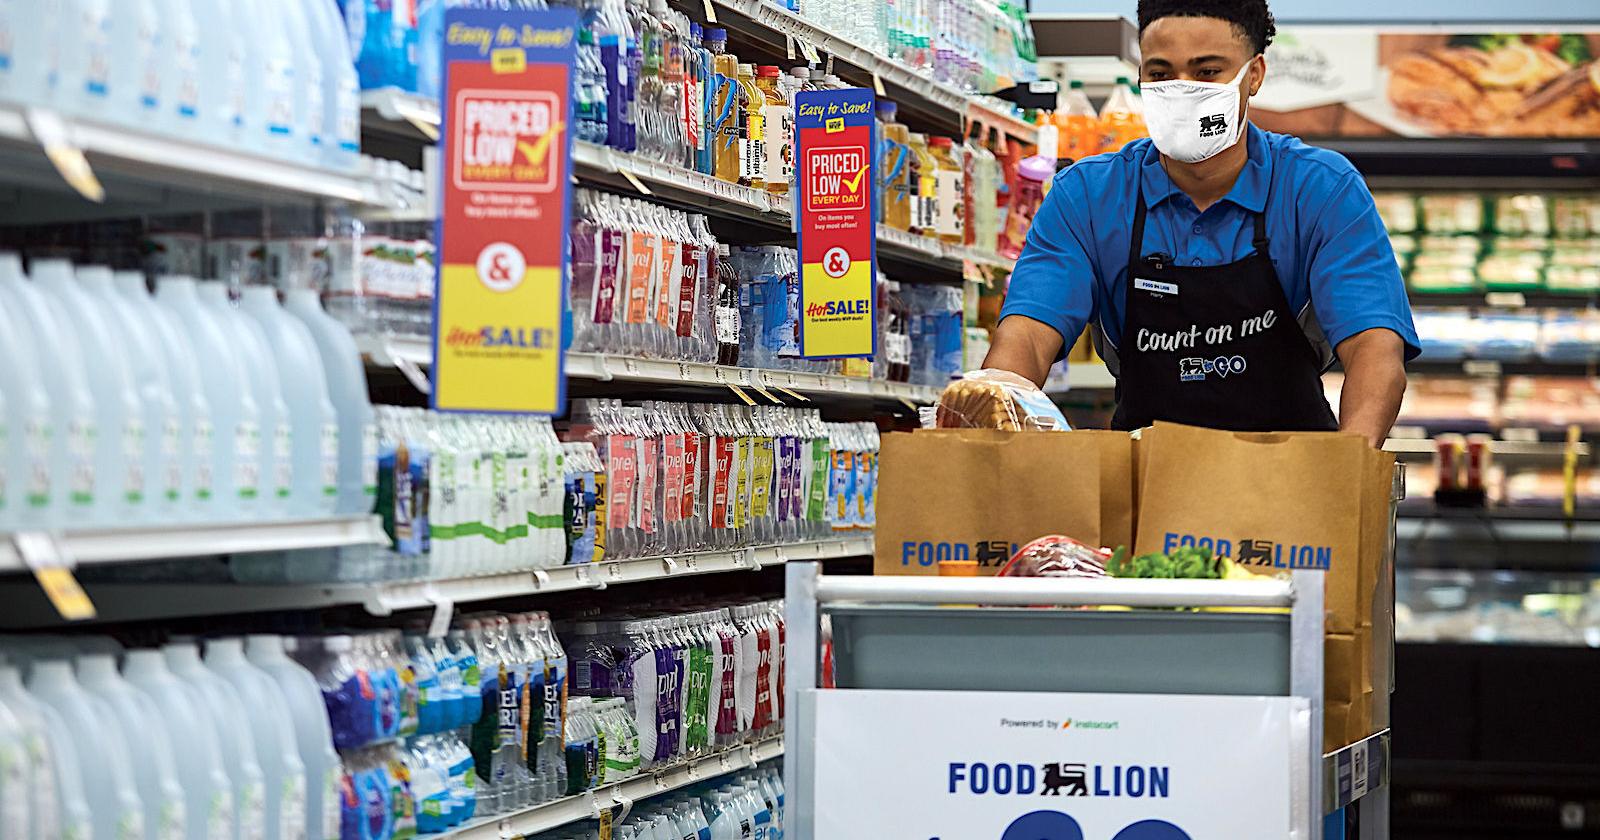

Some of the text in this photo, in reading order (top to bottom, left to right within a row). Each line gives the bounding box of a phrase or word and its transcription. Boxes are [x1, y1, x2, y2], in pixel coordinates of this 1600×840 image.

[465, 101, 549, 135] PRICED
[799, 101, 871, 121] Easy to Save!
[464, 134, 517, 166] LOW
[811, 153, 860, 174] PRICED
[812, 175, 841, 195] LOW
[812, 194, 860, 205] EVERY DAY
[828, 252, 845, 272] &
[1137, 309, 1278, 352] Count on me
[901, 540, 969, 567] FOOD
[1163, 532, 1331, 571] FOOD LION
[1000, 717, 1120, 730] Powered by instacart
[949, 762, 1169, 797] FOOD LION
